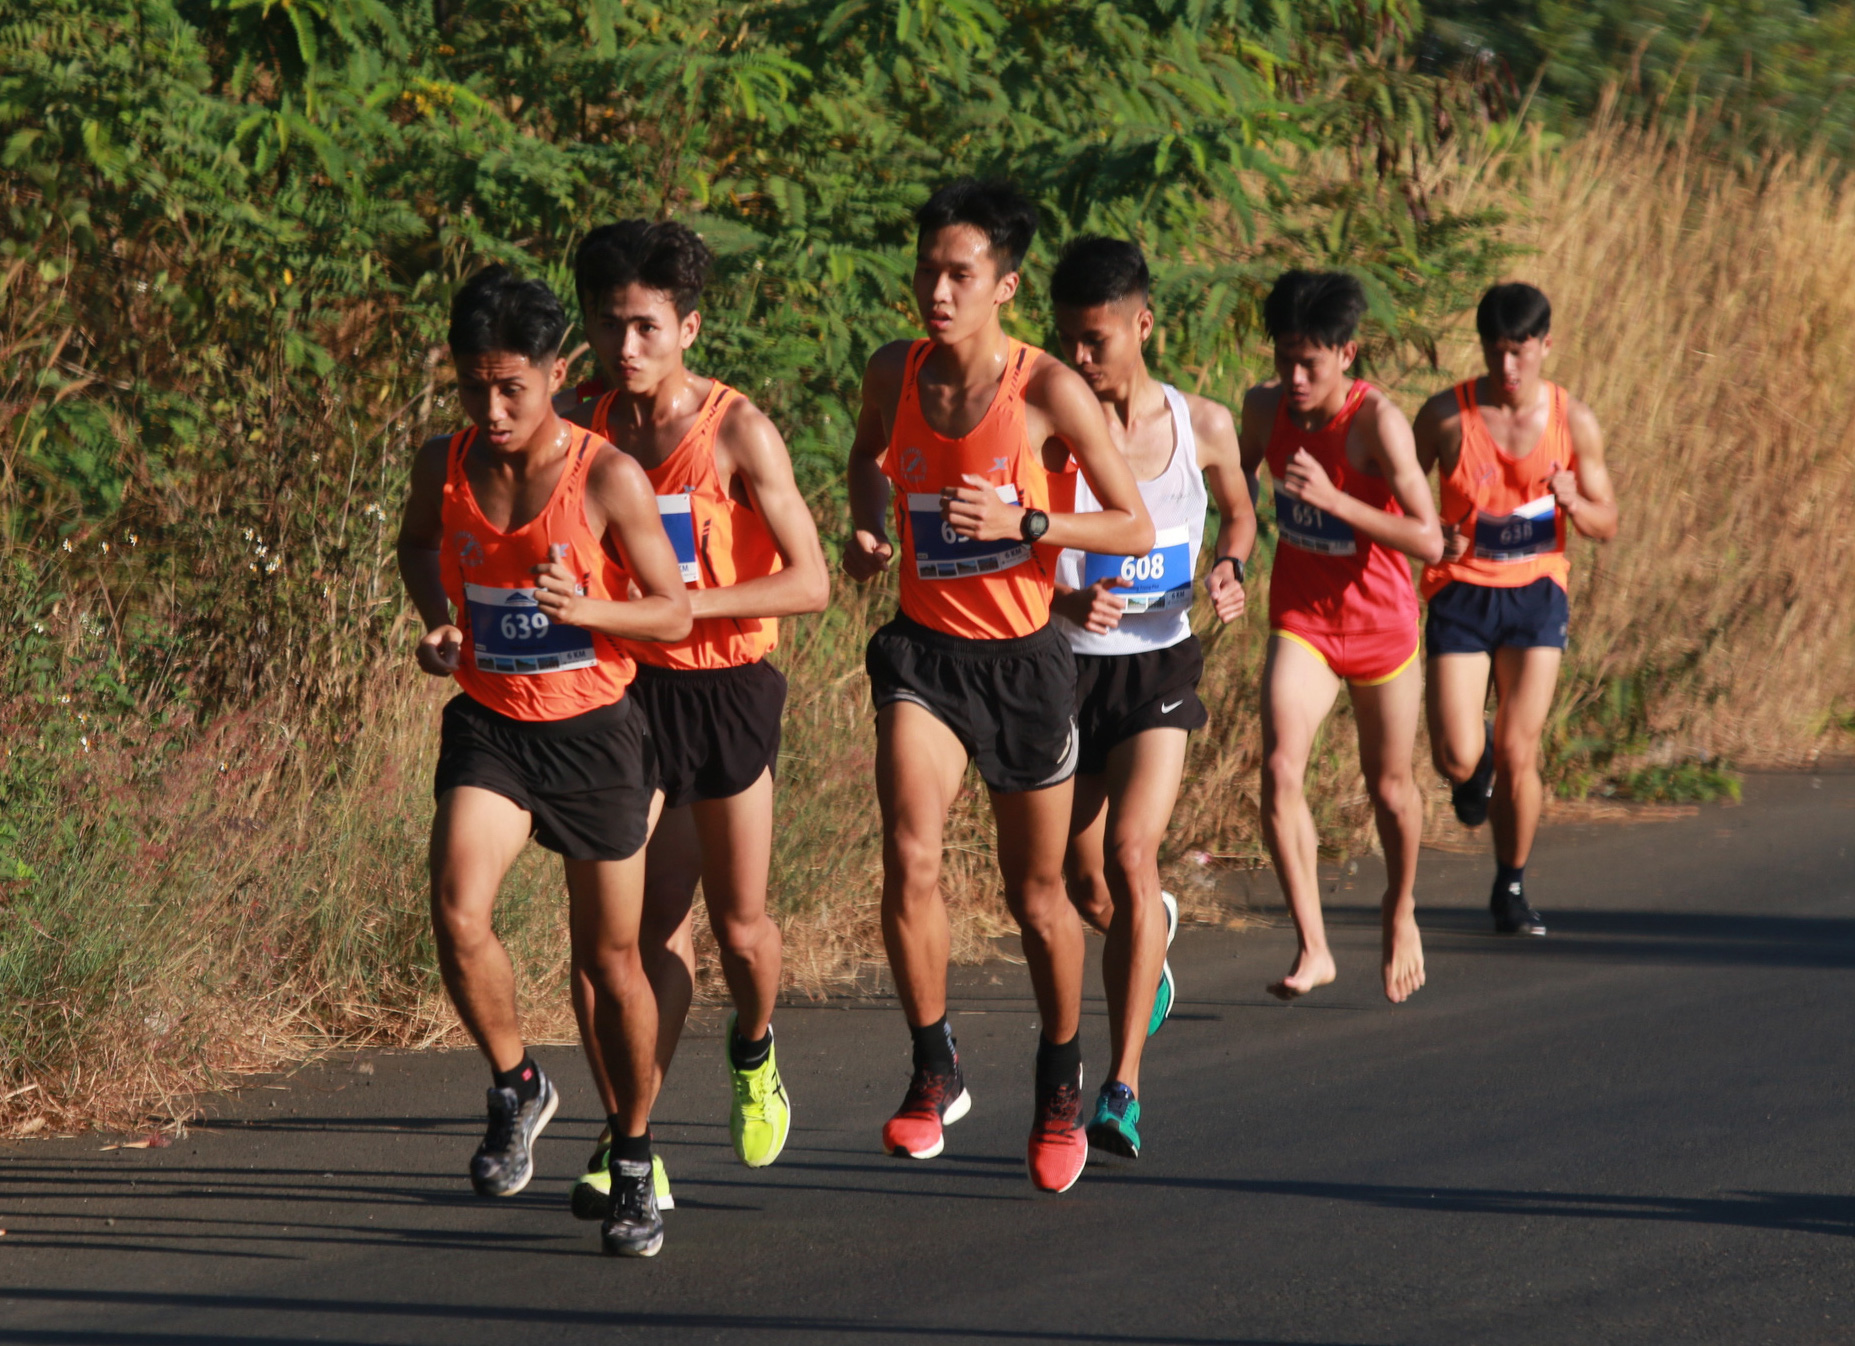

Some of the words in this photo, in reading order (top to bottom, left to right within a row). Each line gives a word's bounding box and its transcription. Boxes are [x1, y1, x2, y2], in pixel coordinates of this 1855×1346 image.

[1292, 502, 1323, 530] 651
[1011, 548, 1022, 557] KM
[1121, 553, 1164, 581] 608
[500, 612, 549, 640] 639
[573, 650, 586, 659] KM
